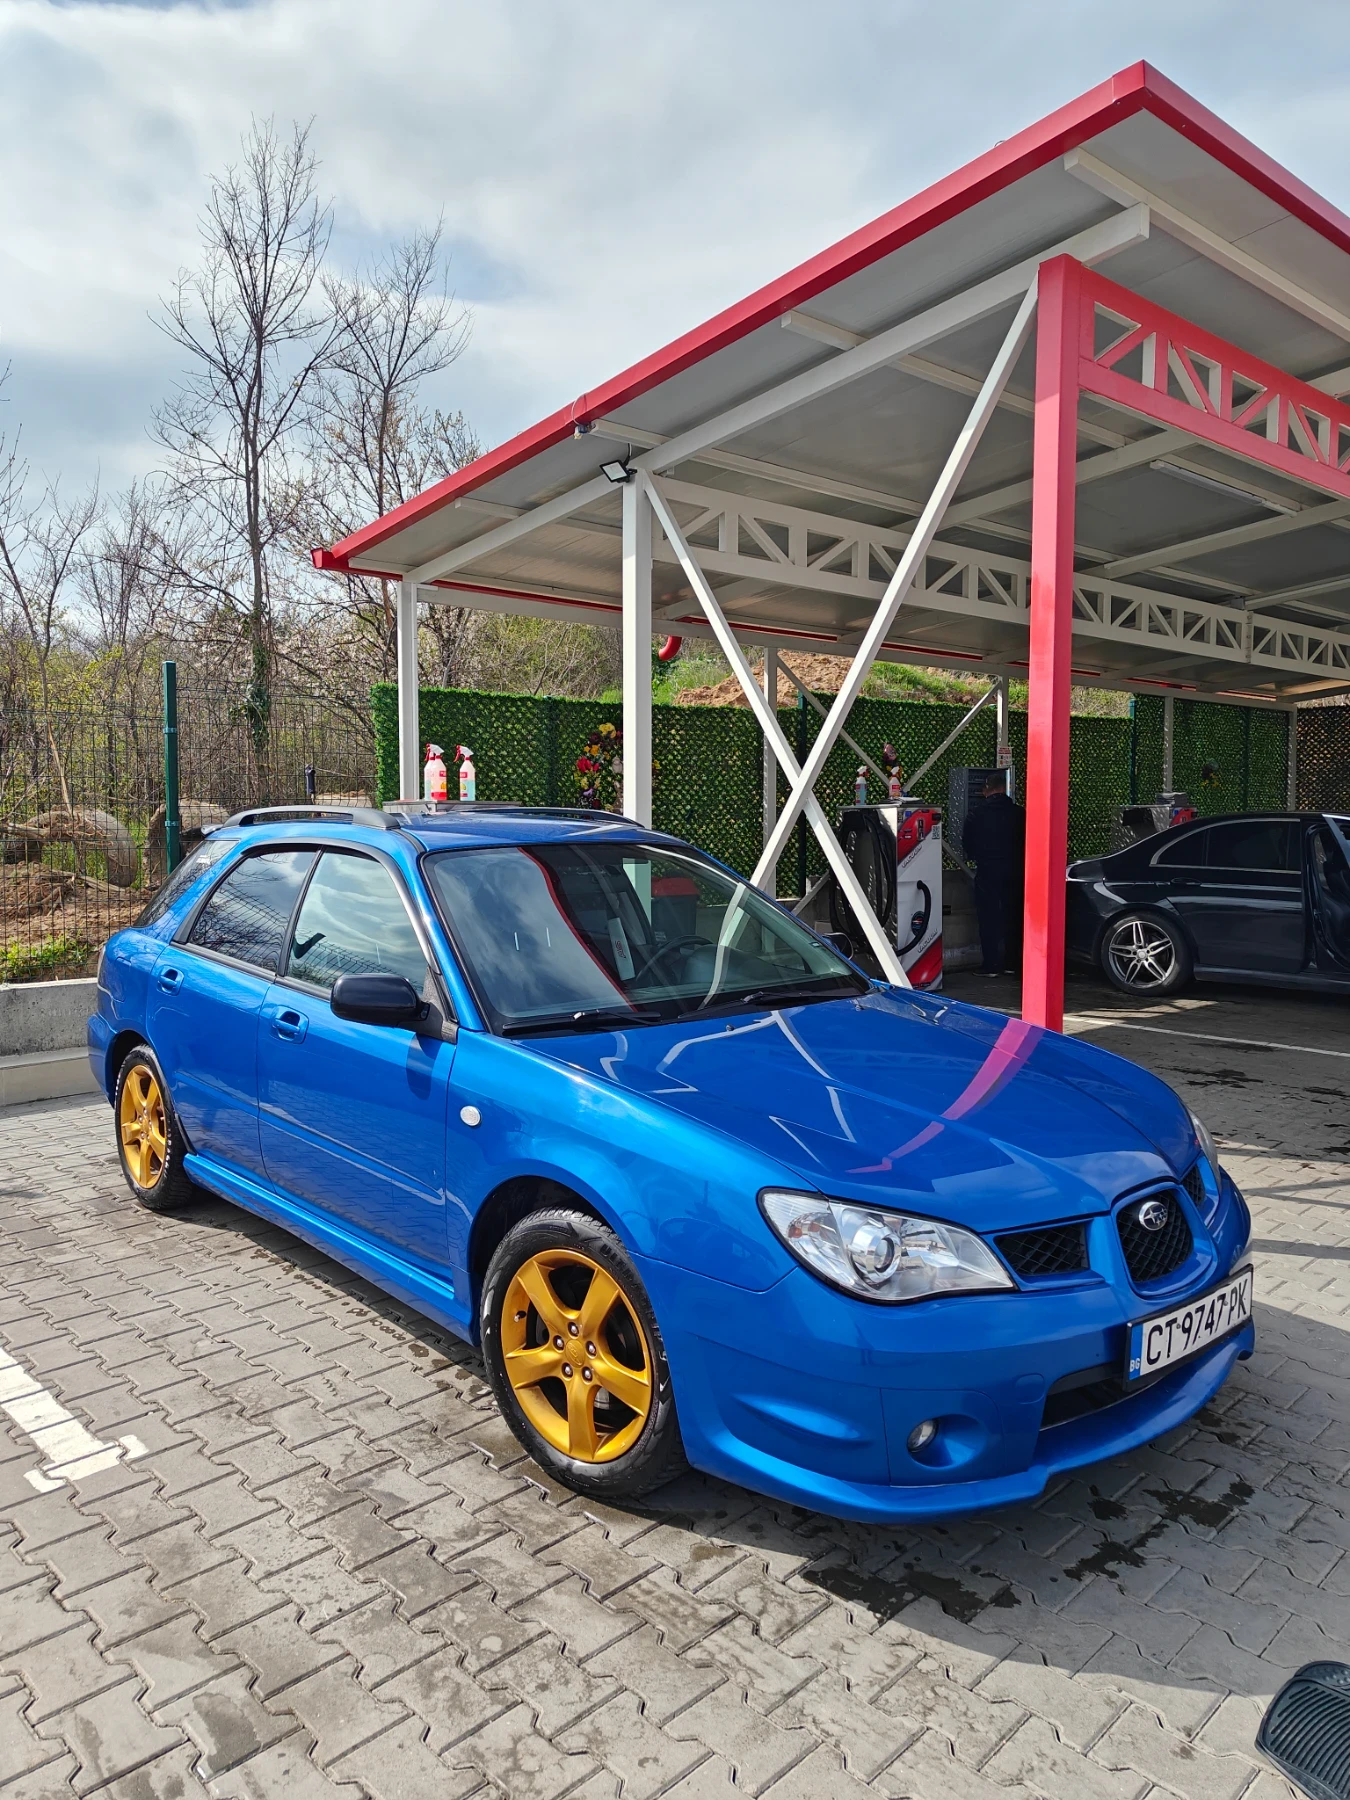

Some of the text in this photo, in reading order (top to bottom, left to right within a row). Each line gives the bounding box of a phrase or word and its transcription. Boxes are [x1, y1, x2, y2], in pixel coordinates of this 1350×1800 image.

[1146, 1279, 1248, 1365] CT 9747 PK
[1129, 1358, 1141, 1372] BG
